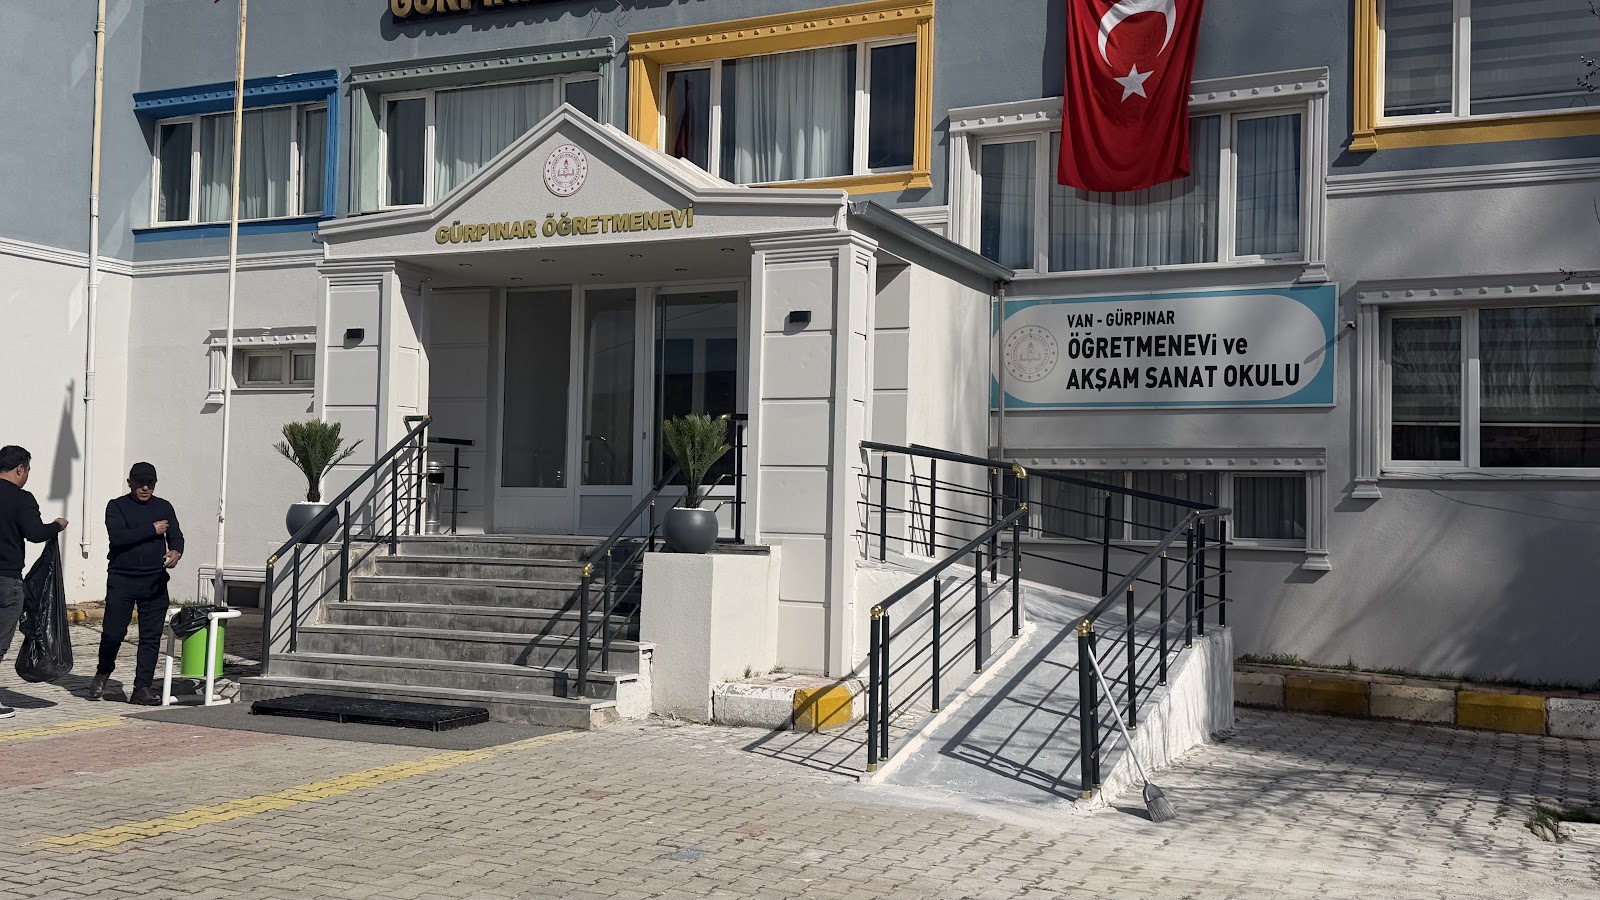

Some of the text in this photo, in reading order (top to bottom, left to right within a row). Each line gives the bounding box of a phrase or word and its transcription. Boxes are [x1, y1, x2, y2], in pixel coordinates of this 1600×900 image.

[435, 203, 694, 244] GÜRPINAR ÖĞRETMENEVİ
[1067, 314, 1093, 328] VAN
[1105, 309, 1175, 327] GÜRPINAR
[1223, 337, 1248, 354] ve
[1066, 363, 1300, 391] AKŞAM SANAT OKULU
